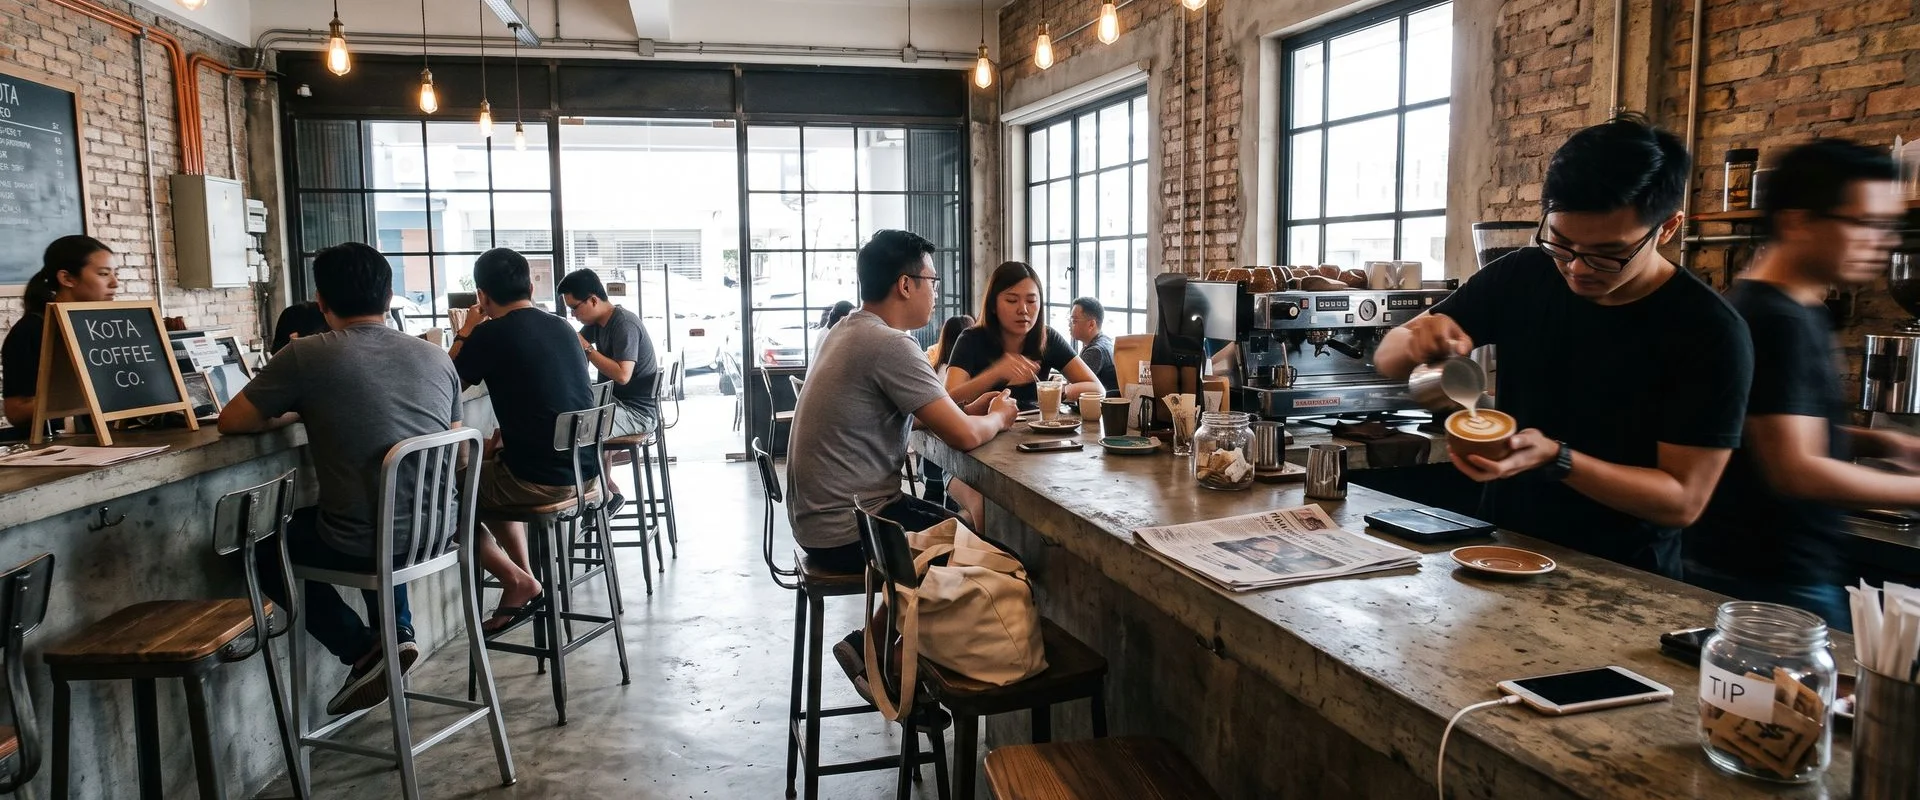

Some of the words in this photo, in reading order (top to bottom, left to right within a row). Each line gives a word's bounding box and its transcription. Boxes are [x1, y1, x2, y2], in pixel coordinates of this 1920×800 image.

[85, 319, 141, 340] KOTA
[89, 345, 156, 366] COFFEE
[1709, 675, 1745, 703] TIP
